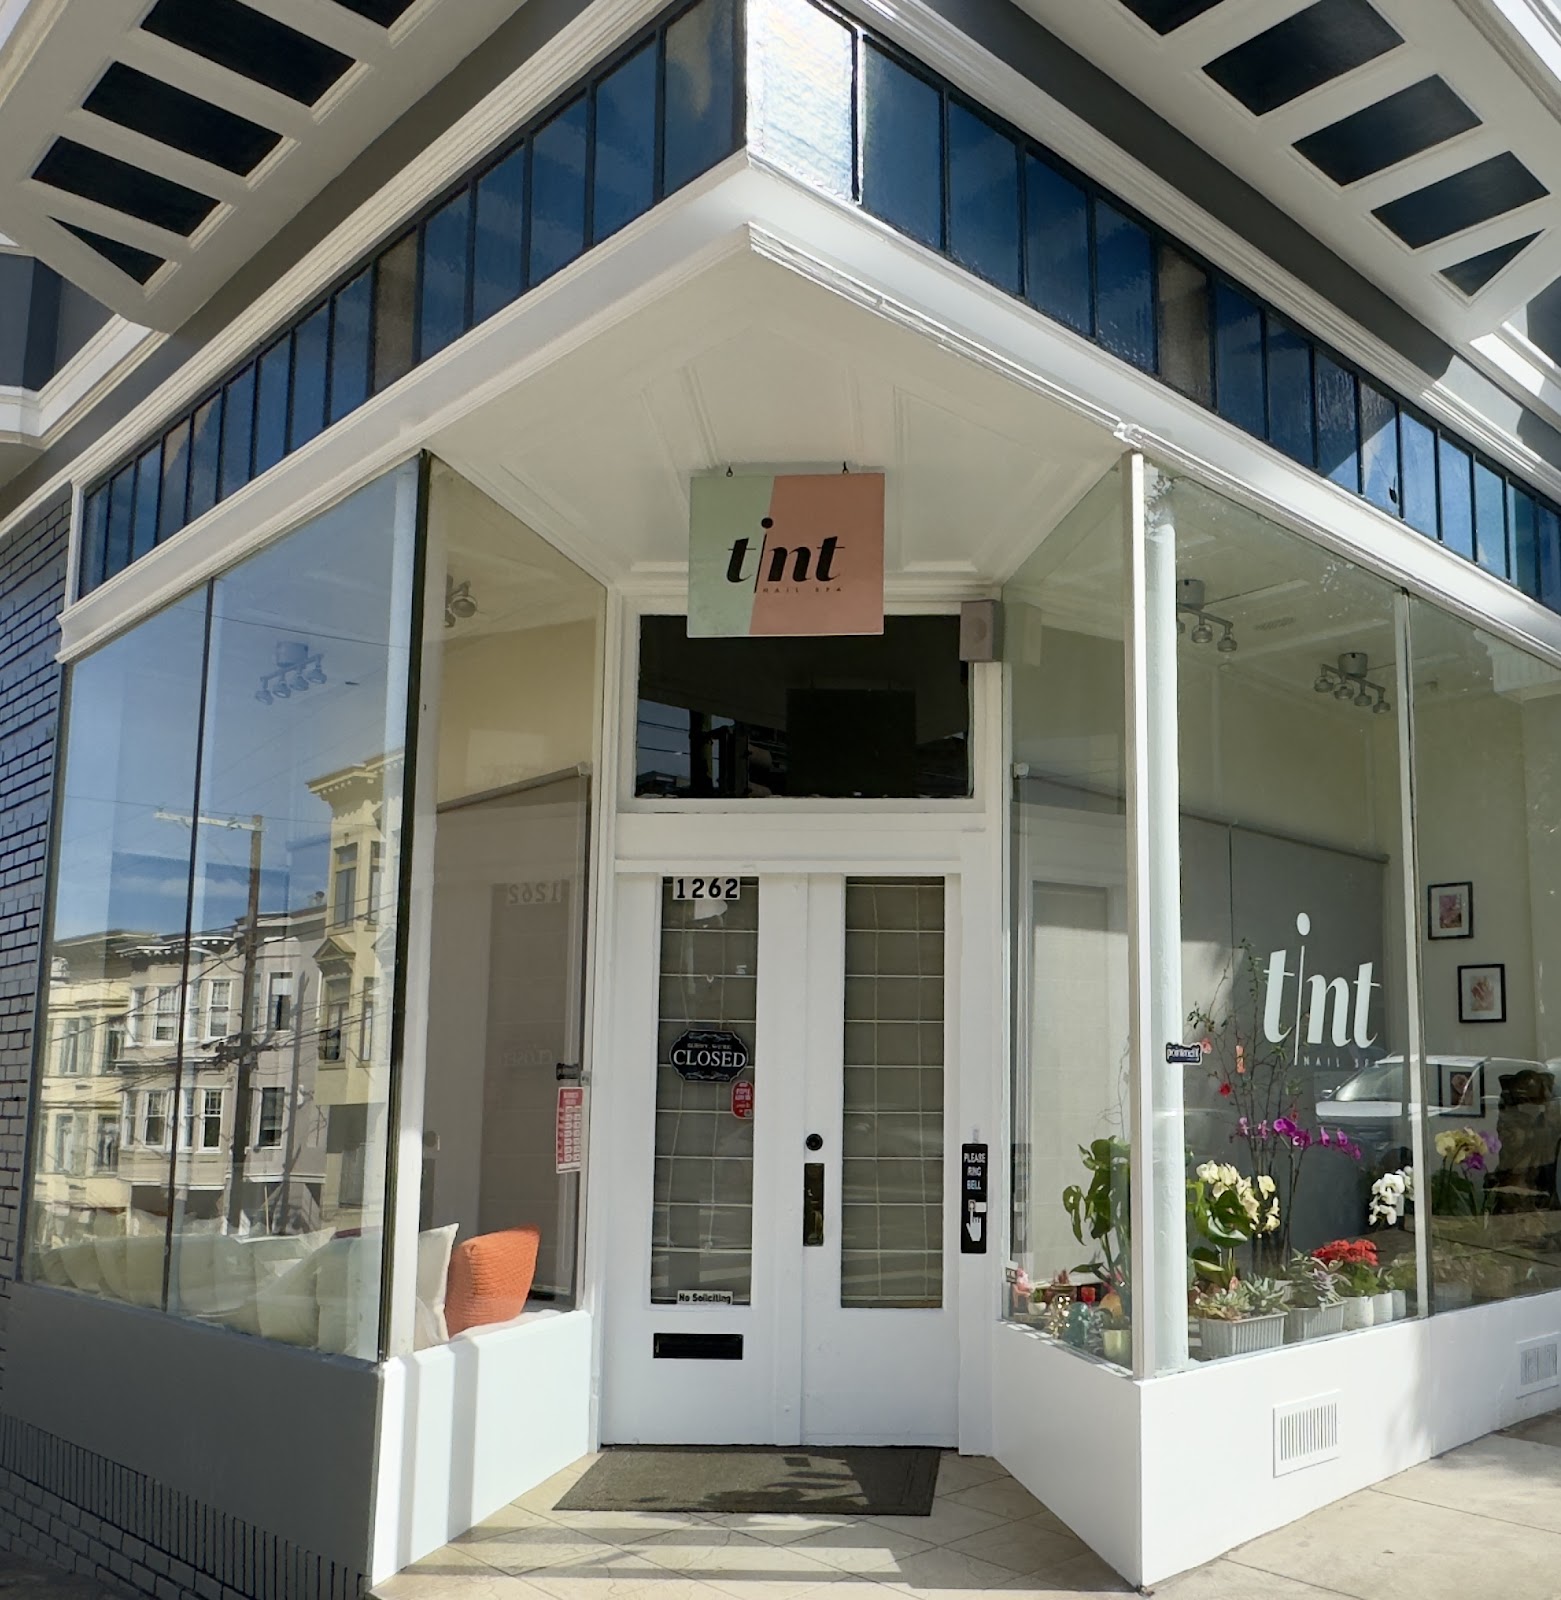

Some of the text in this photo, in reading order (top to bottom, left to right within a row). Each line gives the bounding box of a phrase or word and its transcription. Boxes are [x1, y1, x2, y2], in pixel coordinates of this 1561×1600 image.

[726, 517, 846, 594] tint
[676, 877, 738, 899] 1262
[1263, 912, 1382, 1066] tint
[673, 1049, 746, 1068] CLOSED
[1303, 1055, 1341, 1069] NAIL
[963, 1152, 986, 1164] PLEASE
[966, 1166, 982, 1177] RING
[966, 1179, 982, 1190] BELL
[679, 1293, 731, 1305] No Soliciting
